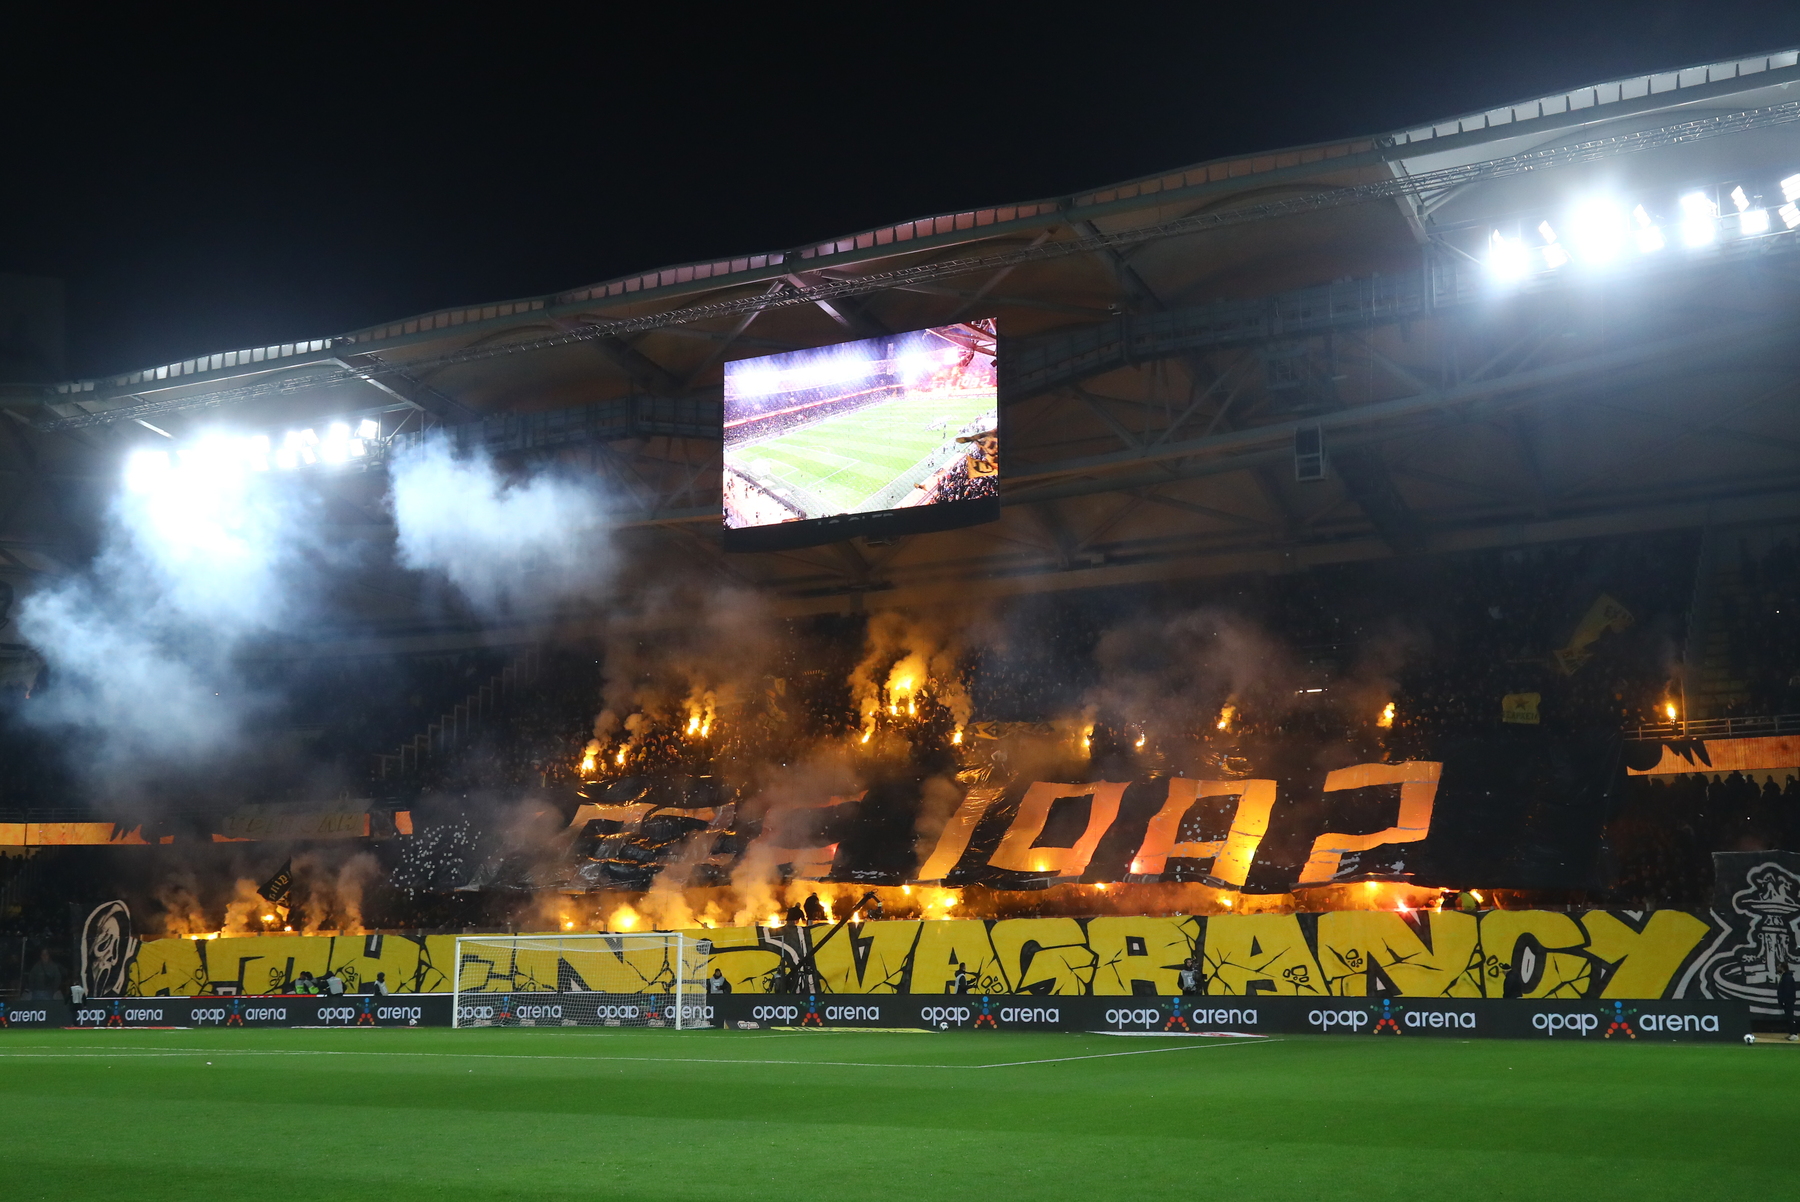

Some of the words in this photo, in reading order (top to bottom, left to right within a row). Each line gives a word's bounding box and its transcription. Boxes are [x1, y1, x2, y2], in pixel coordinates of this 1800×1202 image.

[812, 908, 1709, 998] VAGRANCY
[9, 1010, 46, 1022] arena
[124, 1009, 163, 1021] arena
[190, 1008, 226, 1025] opap
[245, 1008, 287, 1021] arena
[317, 1007, 355, 1024] opap
[377, 1006, 421, 1020] arena
[516, 1005, 562, 1019] arena
[597, 1005, 640, 1020] opap
[664, 1006, 714, 1020] aena
[752, 1005, 799, 1024] opap
[825, 1006, 880, 1021] arena
[921, 1006, 970, 1026] opap
[1000, 1007, 1060, 1023] arena
[1105, 1009, 1160, 1029] opap
[1192, 1008, 1258, 1025] arena
[1308, 1010, 1369, 1032] opap
[1404, 1011, 1476, 1028] arena
[1532, 1013, 1598, 1036] opap
[1639, 1014, 1719, 1032] arena
